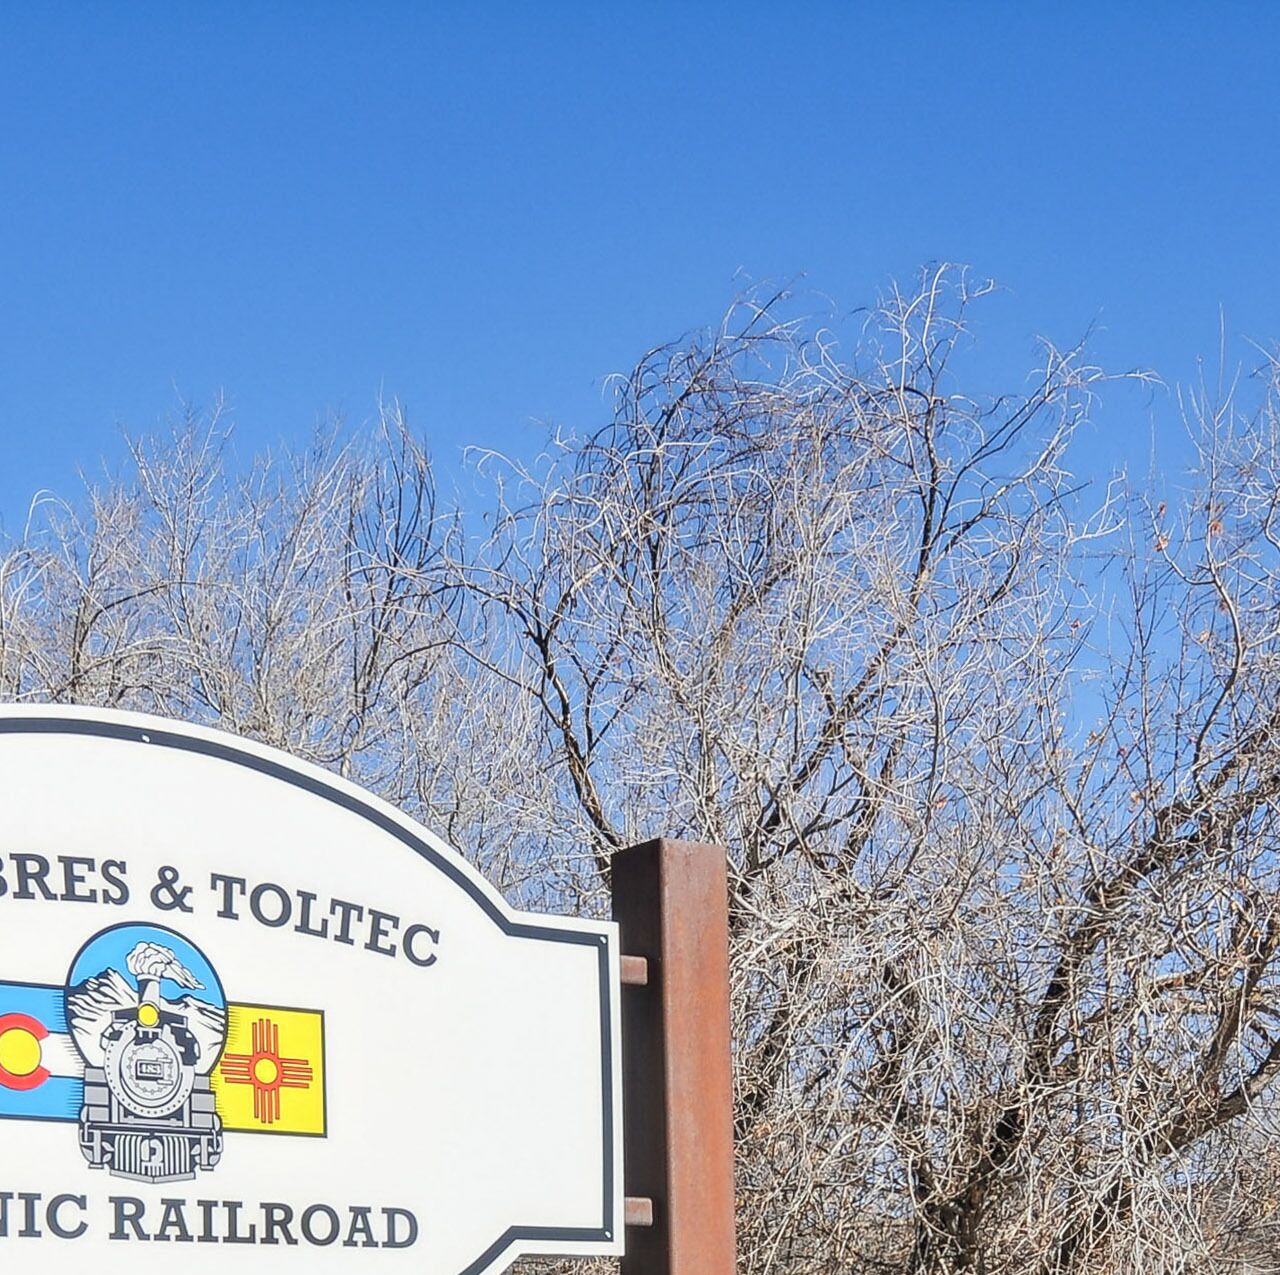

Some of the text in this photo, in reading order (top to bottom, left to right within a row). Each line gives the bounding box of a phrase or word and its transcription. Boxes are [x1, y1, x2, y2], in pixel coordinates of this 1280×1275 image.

[150, 865, 194, 914] &
[210, 872, 440, 967] TOLTEC
[108, 1196, 418, 1249] RAILROAD
